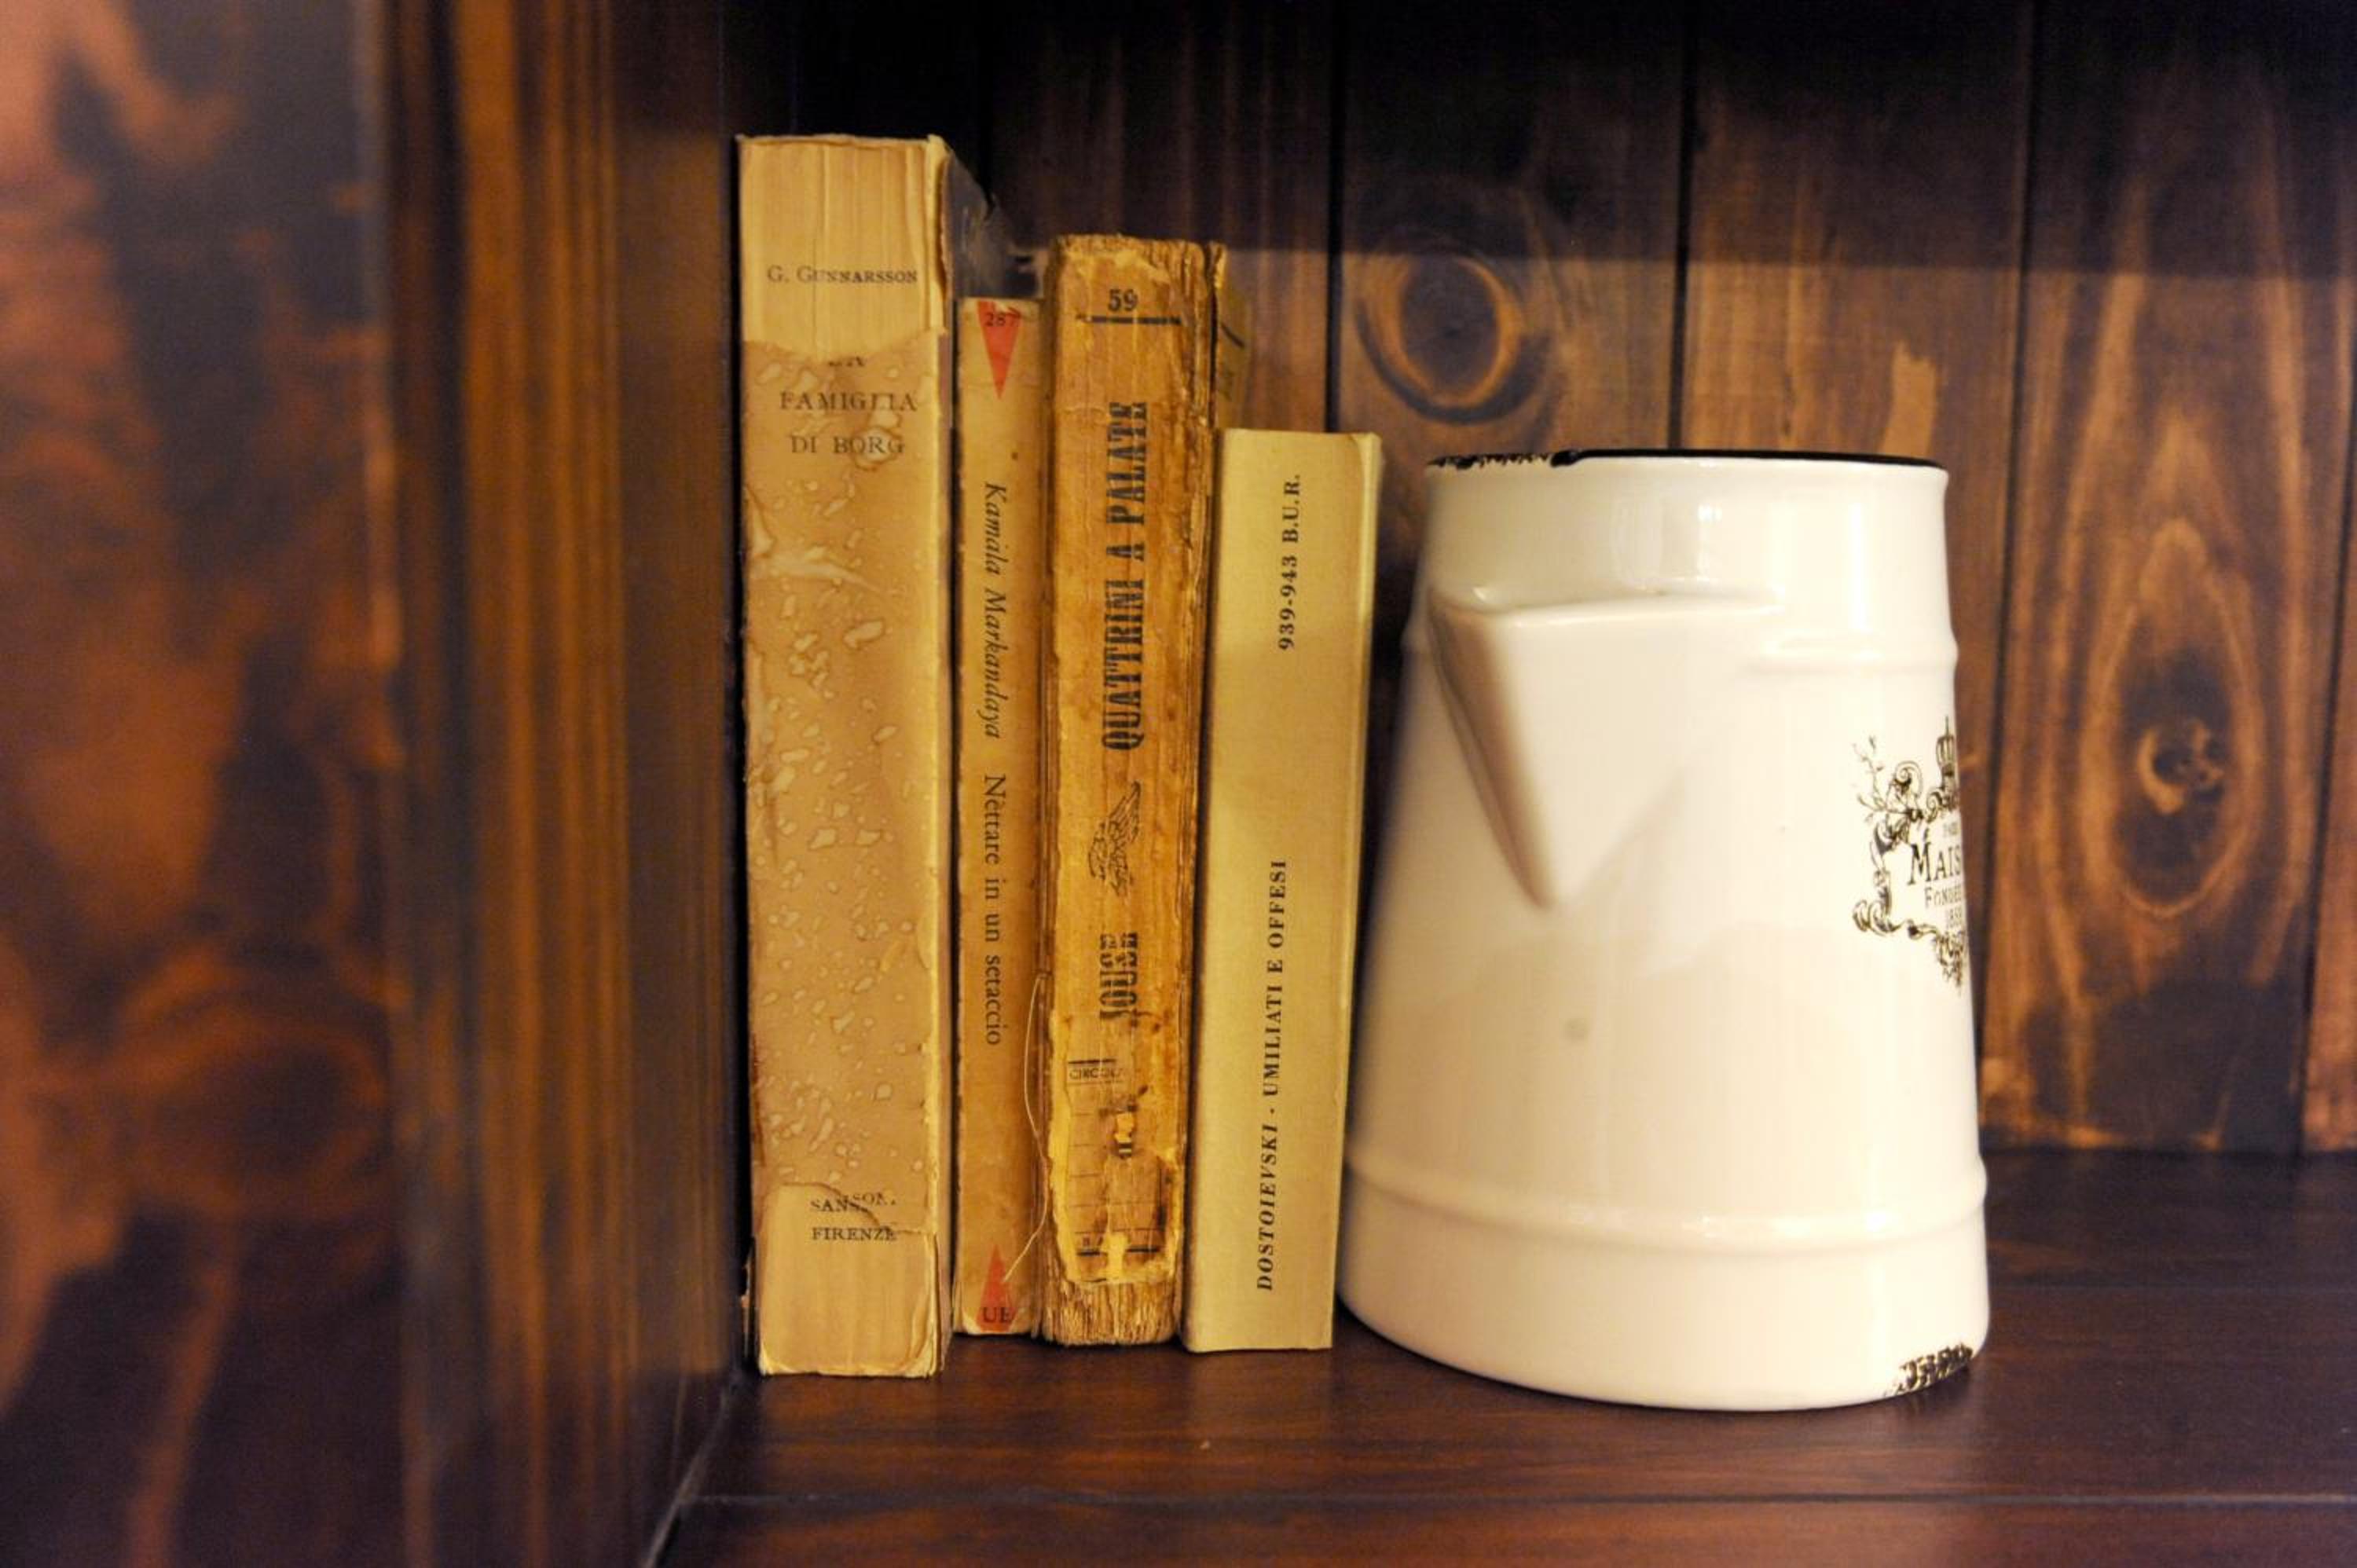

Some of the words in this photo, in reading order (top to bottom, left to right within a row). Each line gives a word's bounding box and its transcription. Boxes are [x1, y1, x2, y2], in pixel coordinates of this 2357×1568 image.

[768, 265, 790, 283] G.
[1108, 288, 1138, 312] 59
[791, 435, 818, 455] DI
[833, 435, 905, 455] BORG
[1105, 401, 1148, 525] PALATE
[984, 482, 1010, 575] Kamala
[1281, 474, 1301, 544] B.U.R.
[1105, 544, 1146, 562] A
[1277, 555, 1299, 651] 939-943
[977, 588, 1010, 738] Markandaya
[1102, 578, 1145, 751] QUATTRINI
[984, 878, 1007, 900] in
[1267, 860, 1288, 949] OFFESI
[984, 913, 1001, 942] un
[984, 954, 1009, 1046] setaccio
[1266, 958, 1284, 974] E
[1262, 985, 1284, 1097] UMILIATI
[810, 1190, 896, 1213] SANSON
[812, 1225, 898, 1242] FIRENZE
[1257, 1124, 1279, 1291] DOSTOIEVSKI
